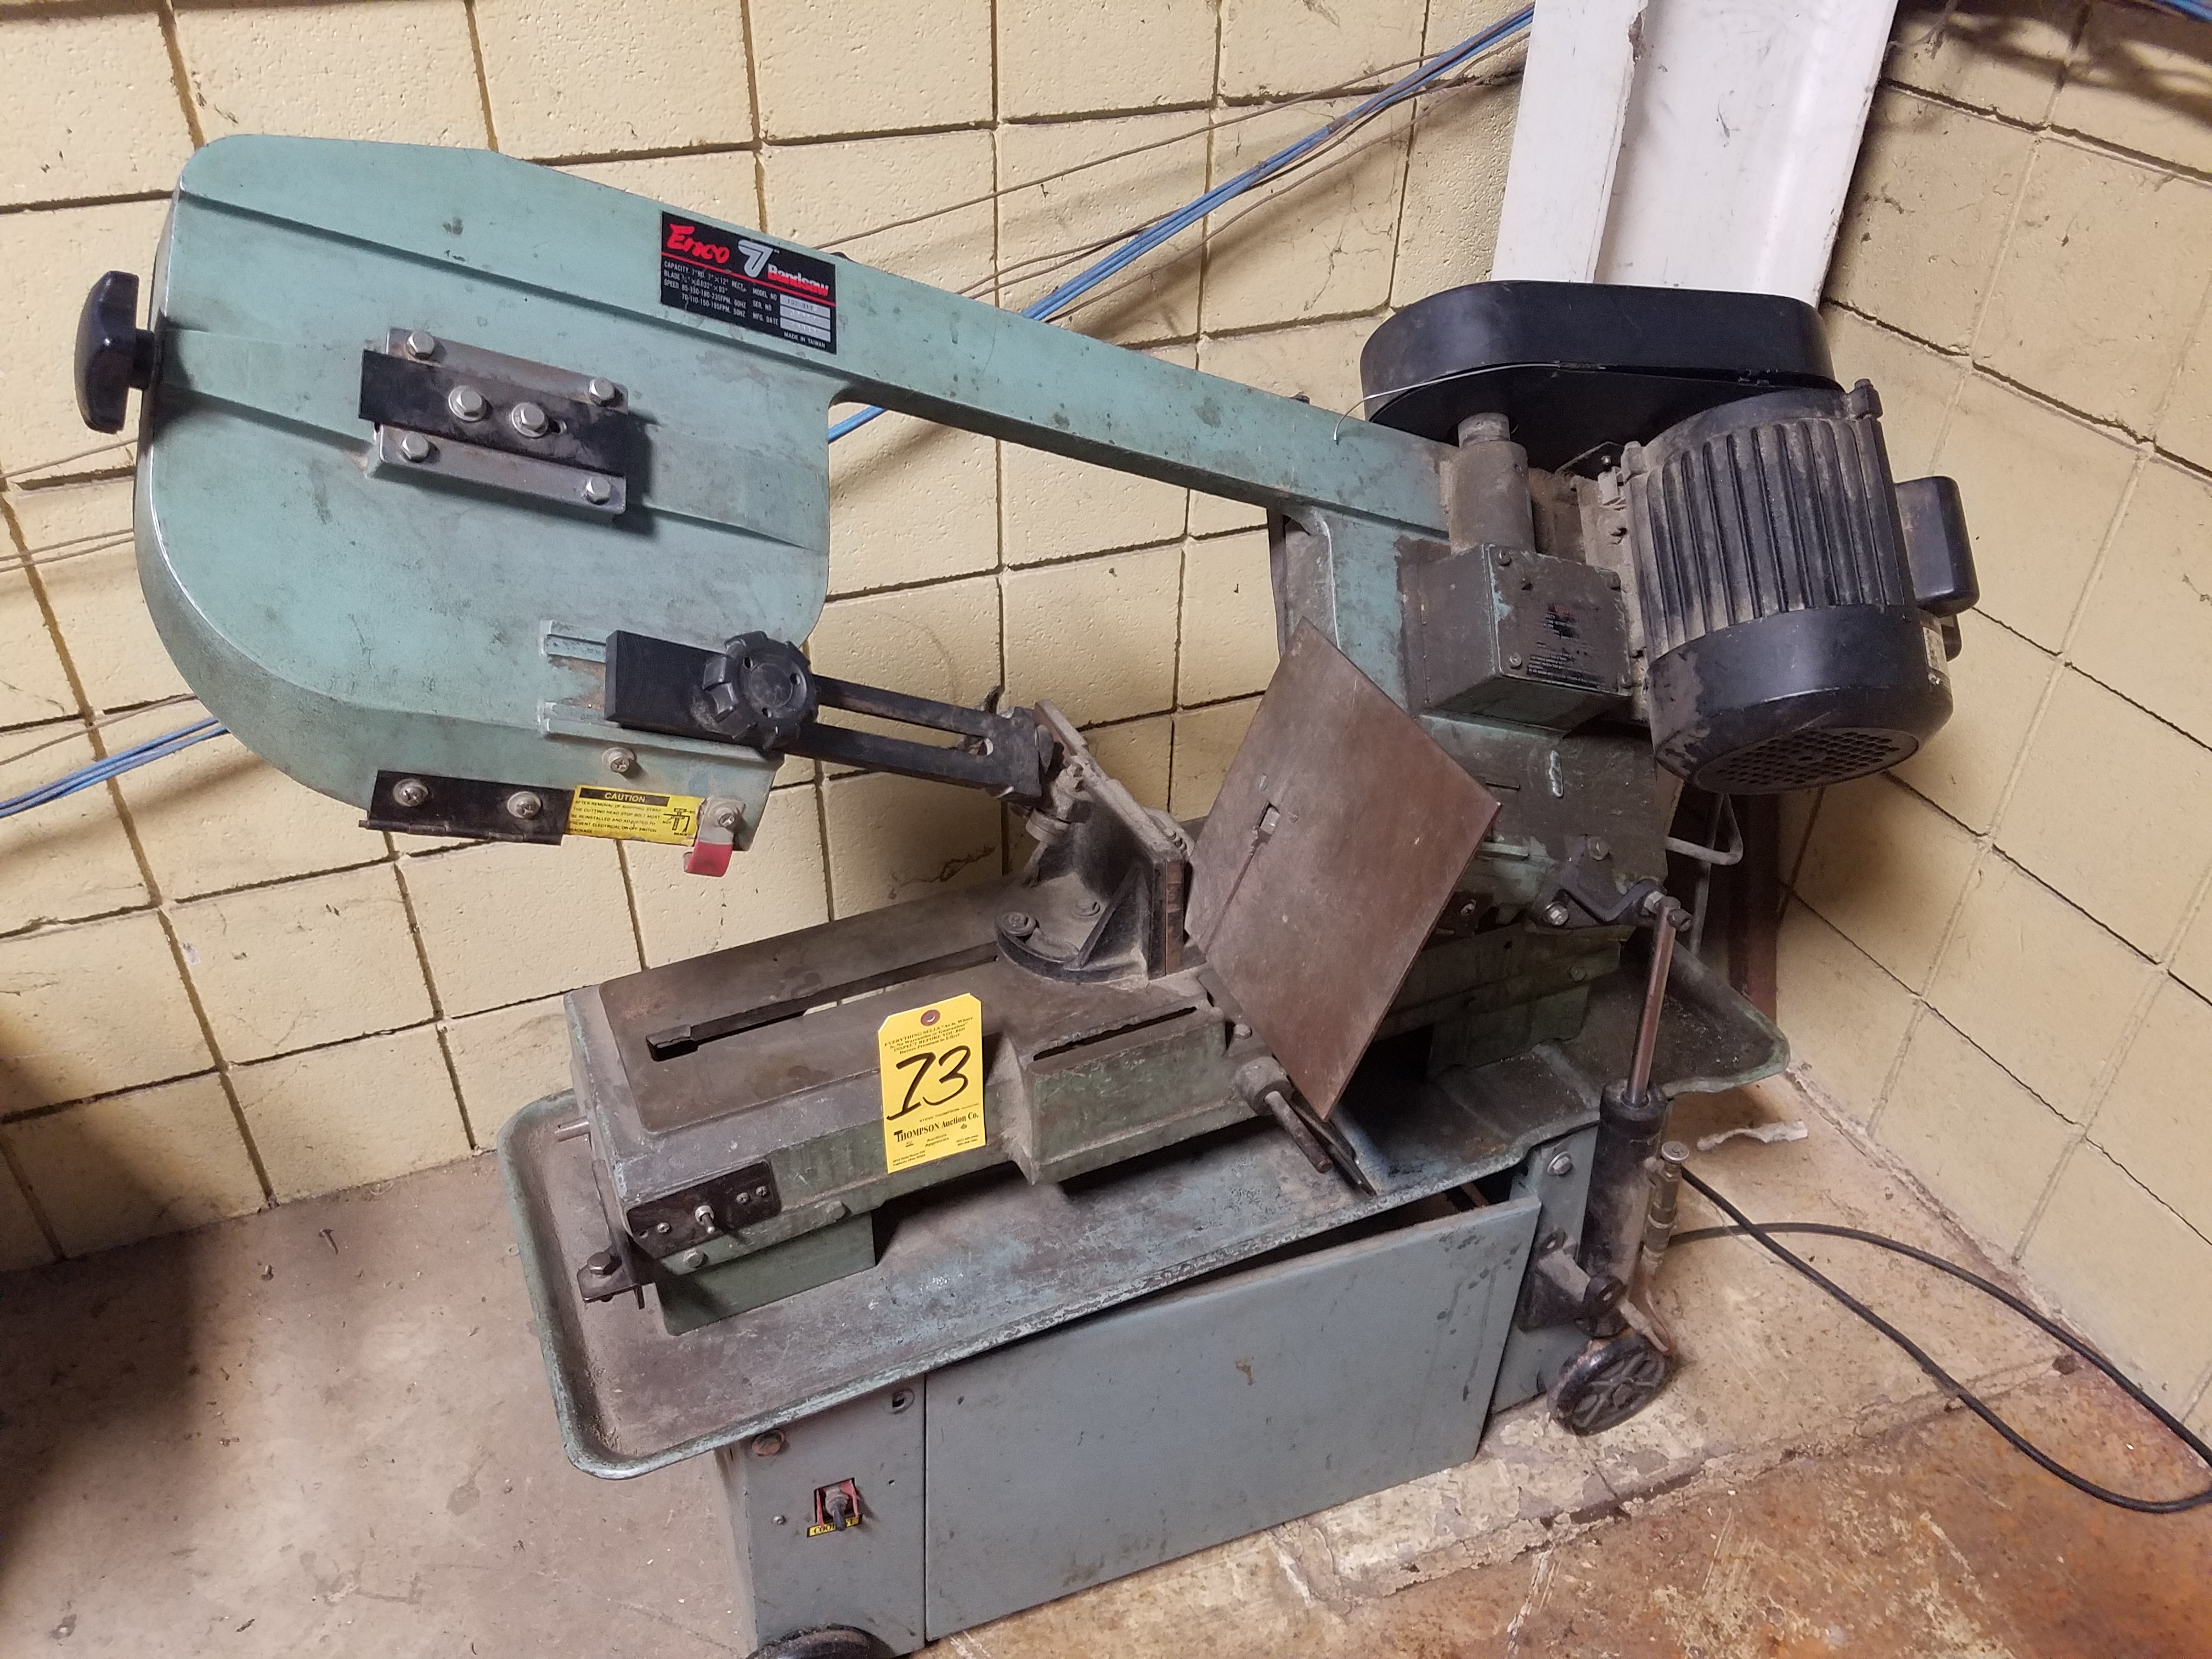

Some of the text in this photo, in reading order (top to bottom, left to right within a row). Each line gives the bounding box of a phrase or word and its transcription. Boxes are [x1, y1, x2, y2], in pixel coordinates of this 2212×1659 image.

[667, 223, 730, 264] Enco
[768, 263, 829, 297] Bandsaw
[664, 269, 680, 280] BLADE
[664, 277, 679, 289] SPEED
[753, 287, 768, 298] MODEL
[753, 300, 763, 309] SER.
[766, 316, 778, 326] DATE
[783, 331, 798, 340] MADE
[808, 338, 826, 348] TAIWAN
[605, 792, 646, 803] CAUTION
[884, 1030, 922, 1046] EVERYTHING
[894, 1042, 917, 1052] INSPECT
[919, 1035, 940, 1045] BEFORE
[887, 1045, 971, 1121] 73
[935, 1108, 960, 1118] THOMPSON
[893, 1111, 979, 1143] THOMPSON Auction Co.
